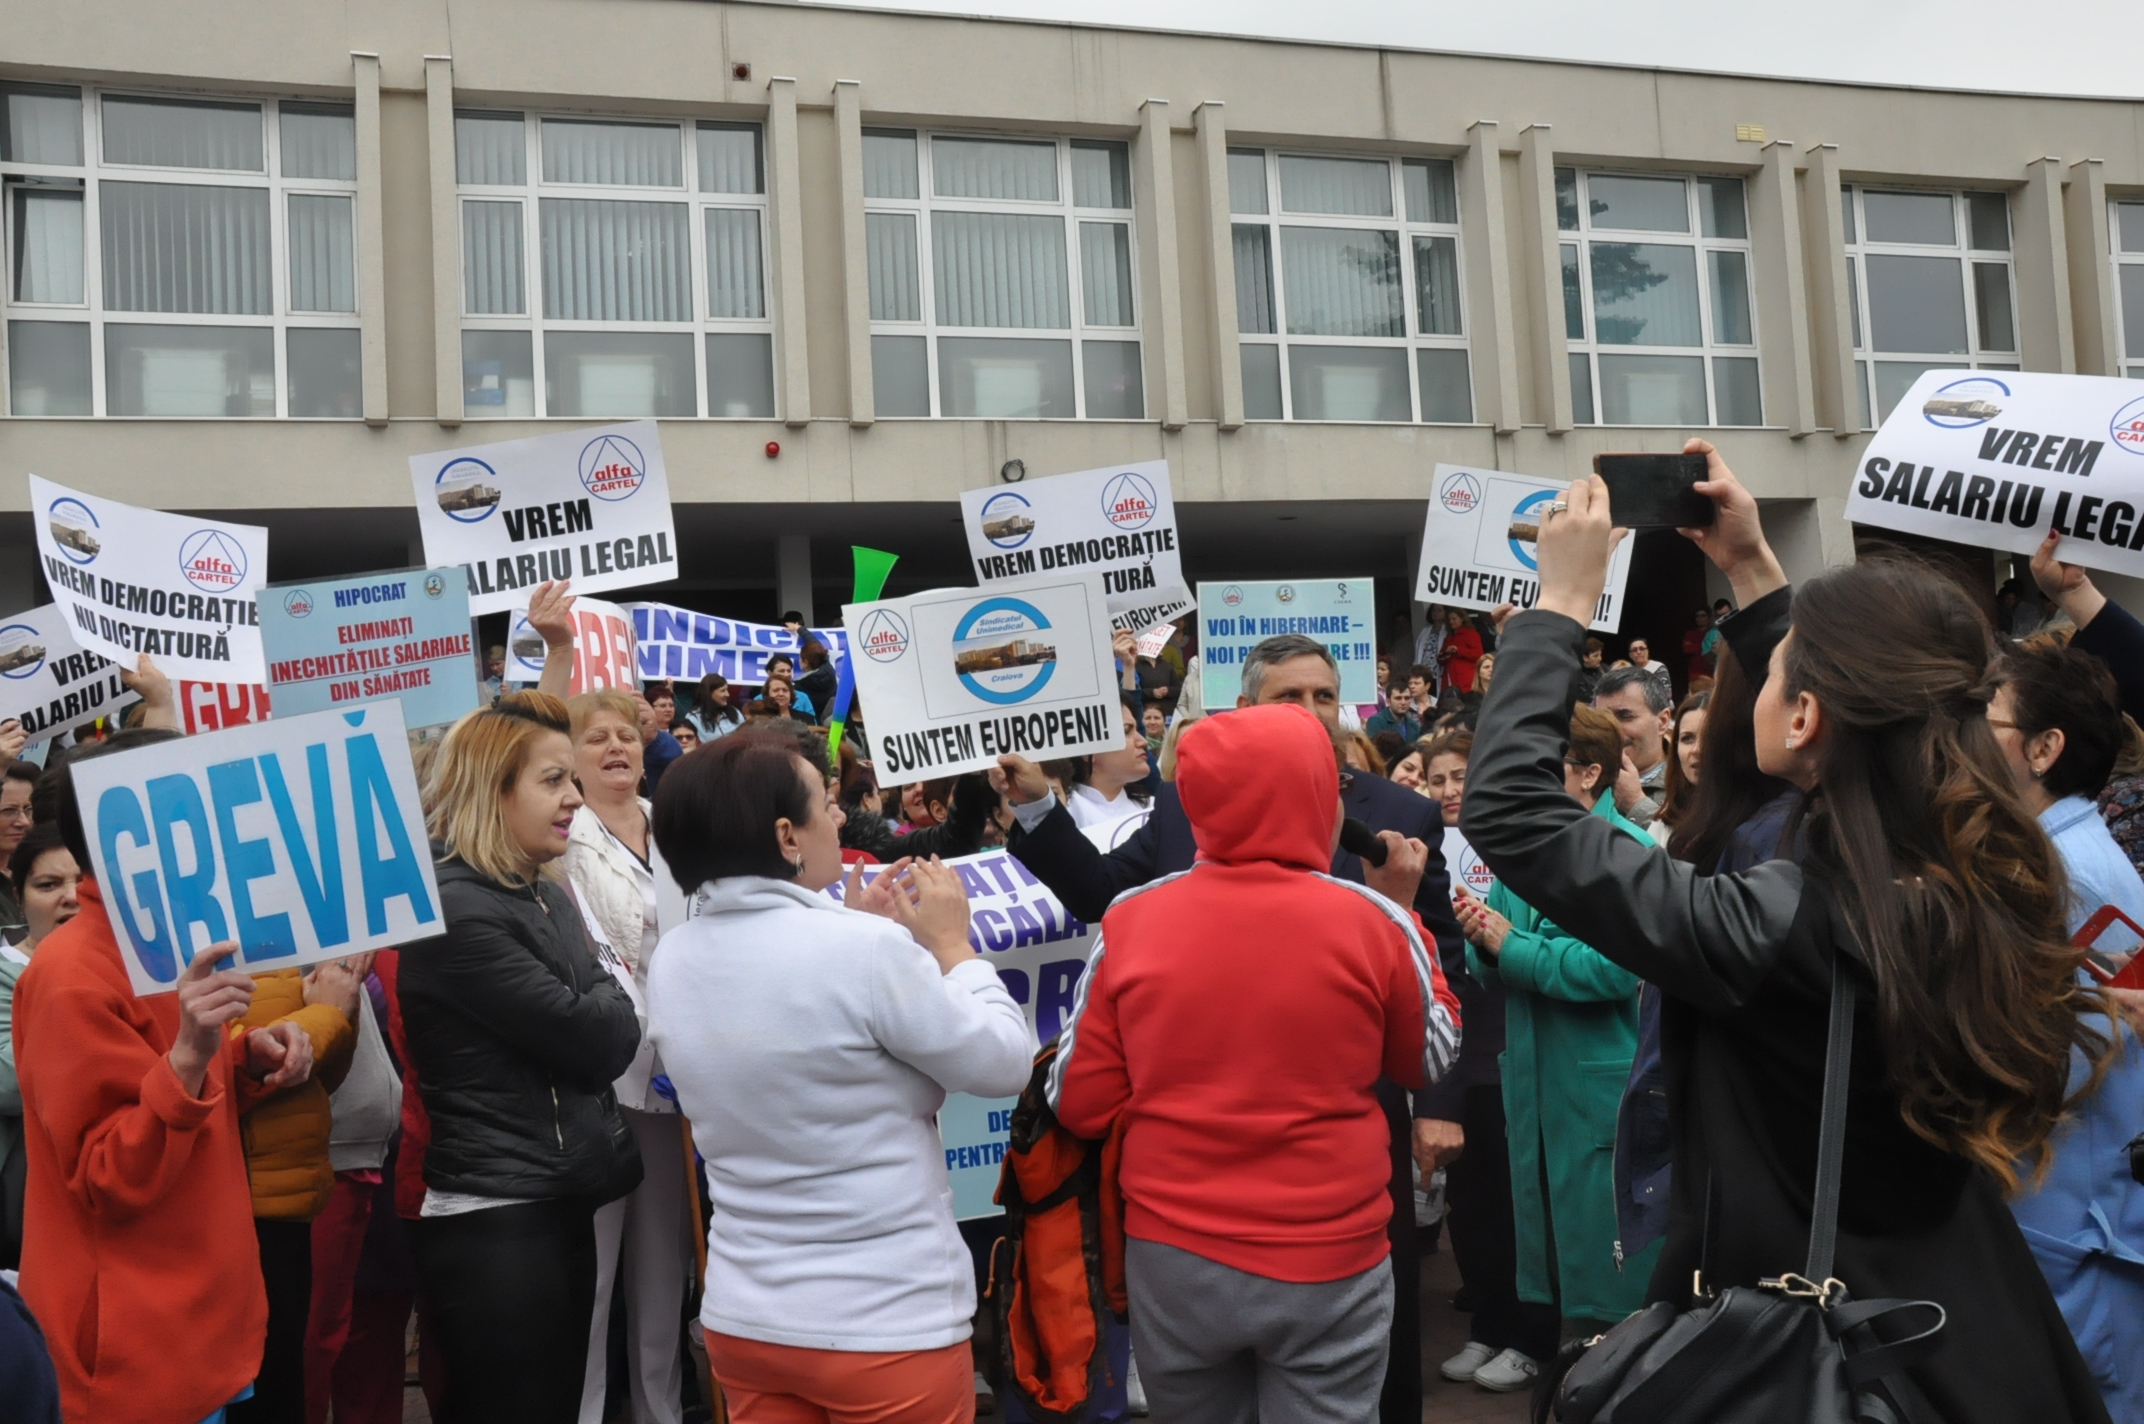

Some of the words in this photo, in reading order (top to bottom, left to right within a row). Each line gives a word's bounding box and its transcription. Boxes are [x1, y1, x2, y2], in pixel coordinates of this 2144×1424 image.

[1978, 427, 2105, 477] VREM
[594, 463, 633, 481] alfa
[591, 479, 638, 493] CARTEL
[1449, 489, 1471, 501] alfa
[1859, 456, 2045, 528] SALARIU
[1115, 497, 1146, 513] alfa
[1445, 499, 1473, 509] CARTEL
[502, 498, 593, 542] VREM
[1112, 511, 1151, 523] CARTEL
[194, 557, 232, 574] alfa
[454, 548, 572, 596] ALARIU
[580, 532, 673, 577] LEGAL
[977, 549, 1036, 580] VREM
[1039, 528, 1175, 570] DEMOCRAȚIE
[44, 553, 97, 600] VREM
[188, 571, 236, 585] CARTEL
[1102, 560, 1156, 595] TURĂ
[1428, 565, 1505, 604] SUNTEM
[333, 582, 407, 608] HIPOCRAT
[73, 602, 98, 636] NU
[99, 614, 231, 662] DICTATURĂ
[976, 622, 1024, 636] Unimedical
[979, 614, 1023, 627] Sindicatul
[1207, 618, 1235, 637] VOI
[1239, 615, 1256, 636] ÎN
[1260, 616, 1349, 635] HIBERNARE
[394, 633, 471, 665] SALARIALE
[871, 631, 898, 645] alfa
[869, 644, 904, 656] CARTEL
[1206, 646, 1234, 664] NOI
[330, 681, 360, 702] DIN
[363, 667, 431, 697] SĂNĂTATE
[991, 672, 1023, 683] Craiova
[883, 723, 977, 774] SUNTEM
[979, 704, 1110, 756] EUROPENI!
[97, 709, 437, 984] GREVĂ
[987, 1108, 1017, 1133] DE
